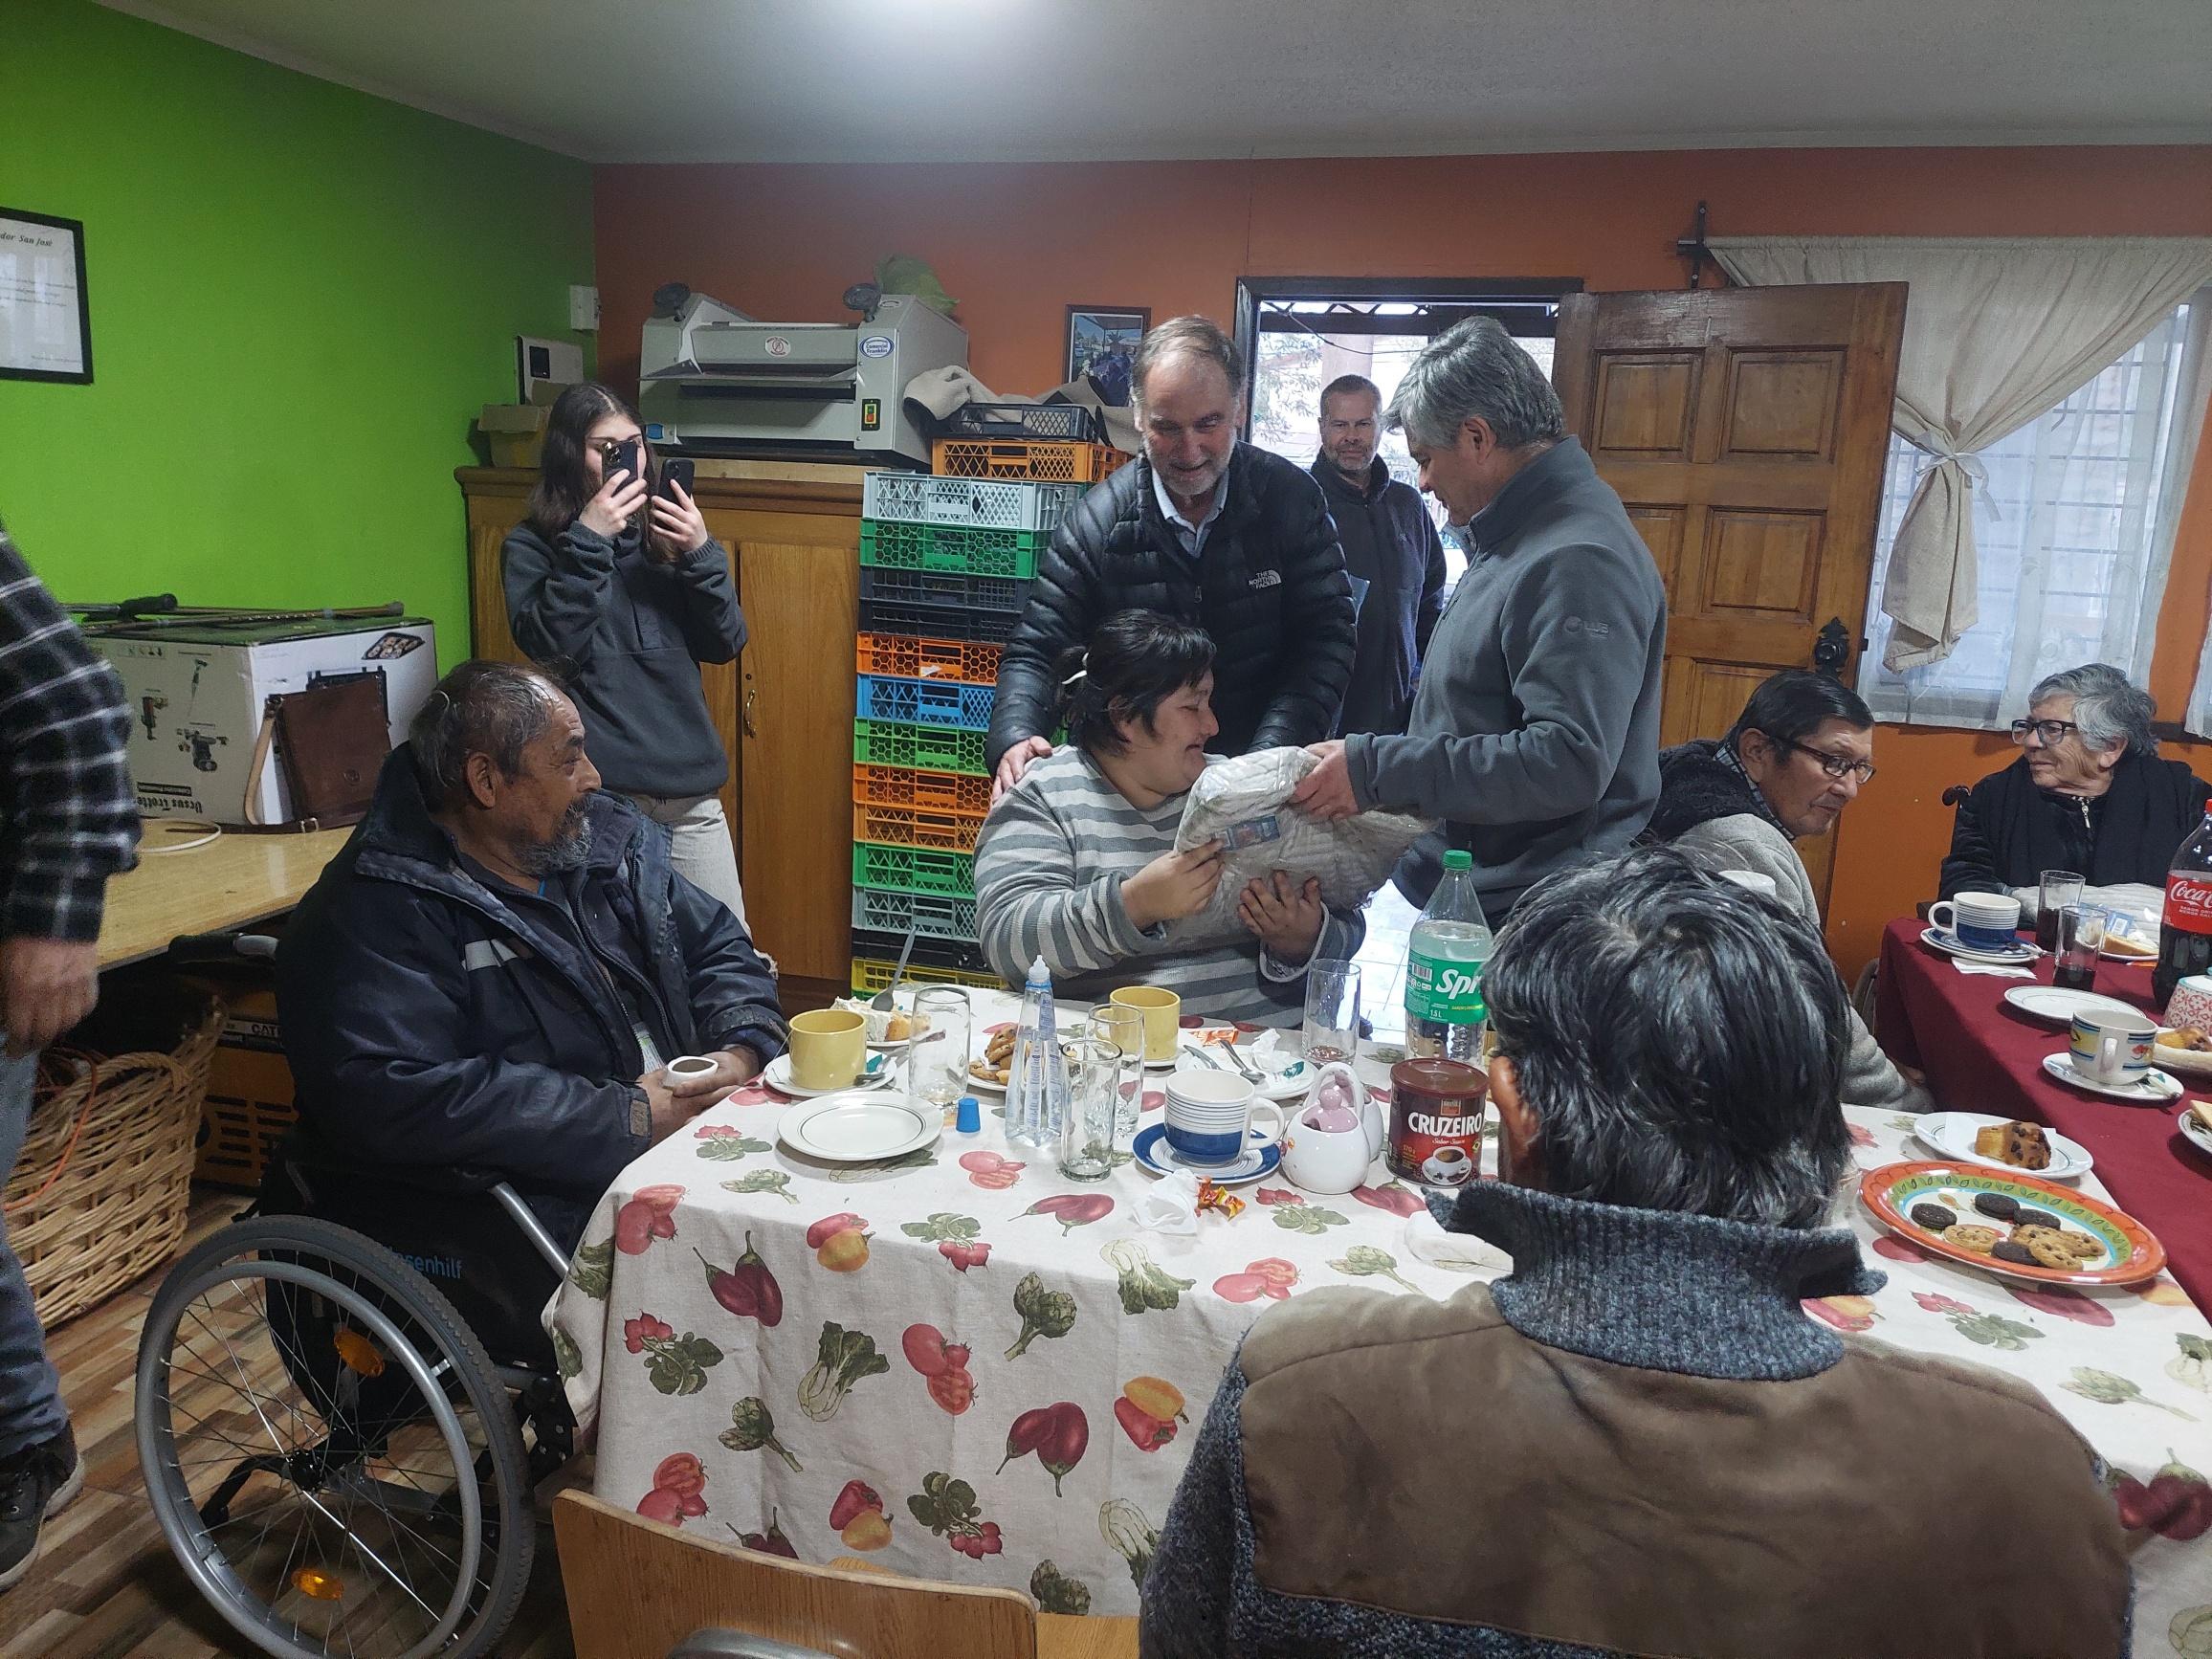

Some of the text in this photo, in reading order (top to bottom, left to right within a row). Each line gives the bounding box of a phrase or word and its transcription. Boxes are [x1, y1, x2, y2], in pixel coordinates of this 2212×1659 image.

[19, 234, 34, 244] San
[133, 797, 171, 813] Trotte
[1407, 1111, 1483, 1138] CRUZEIRO
